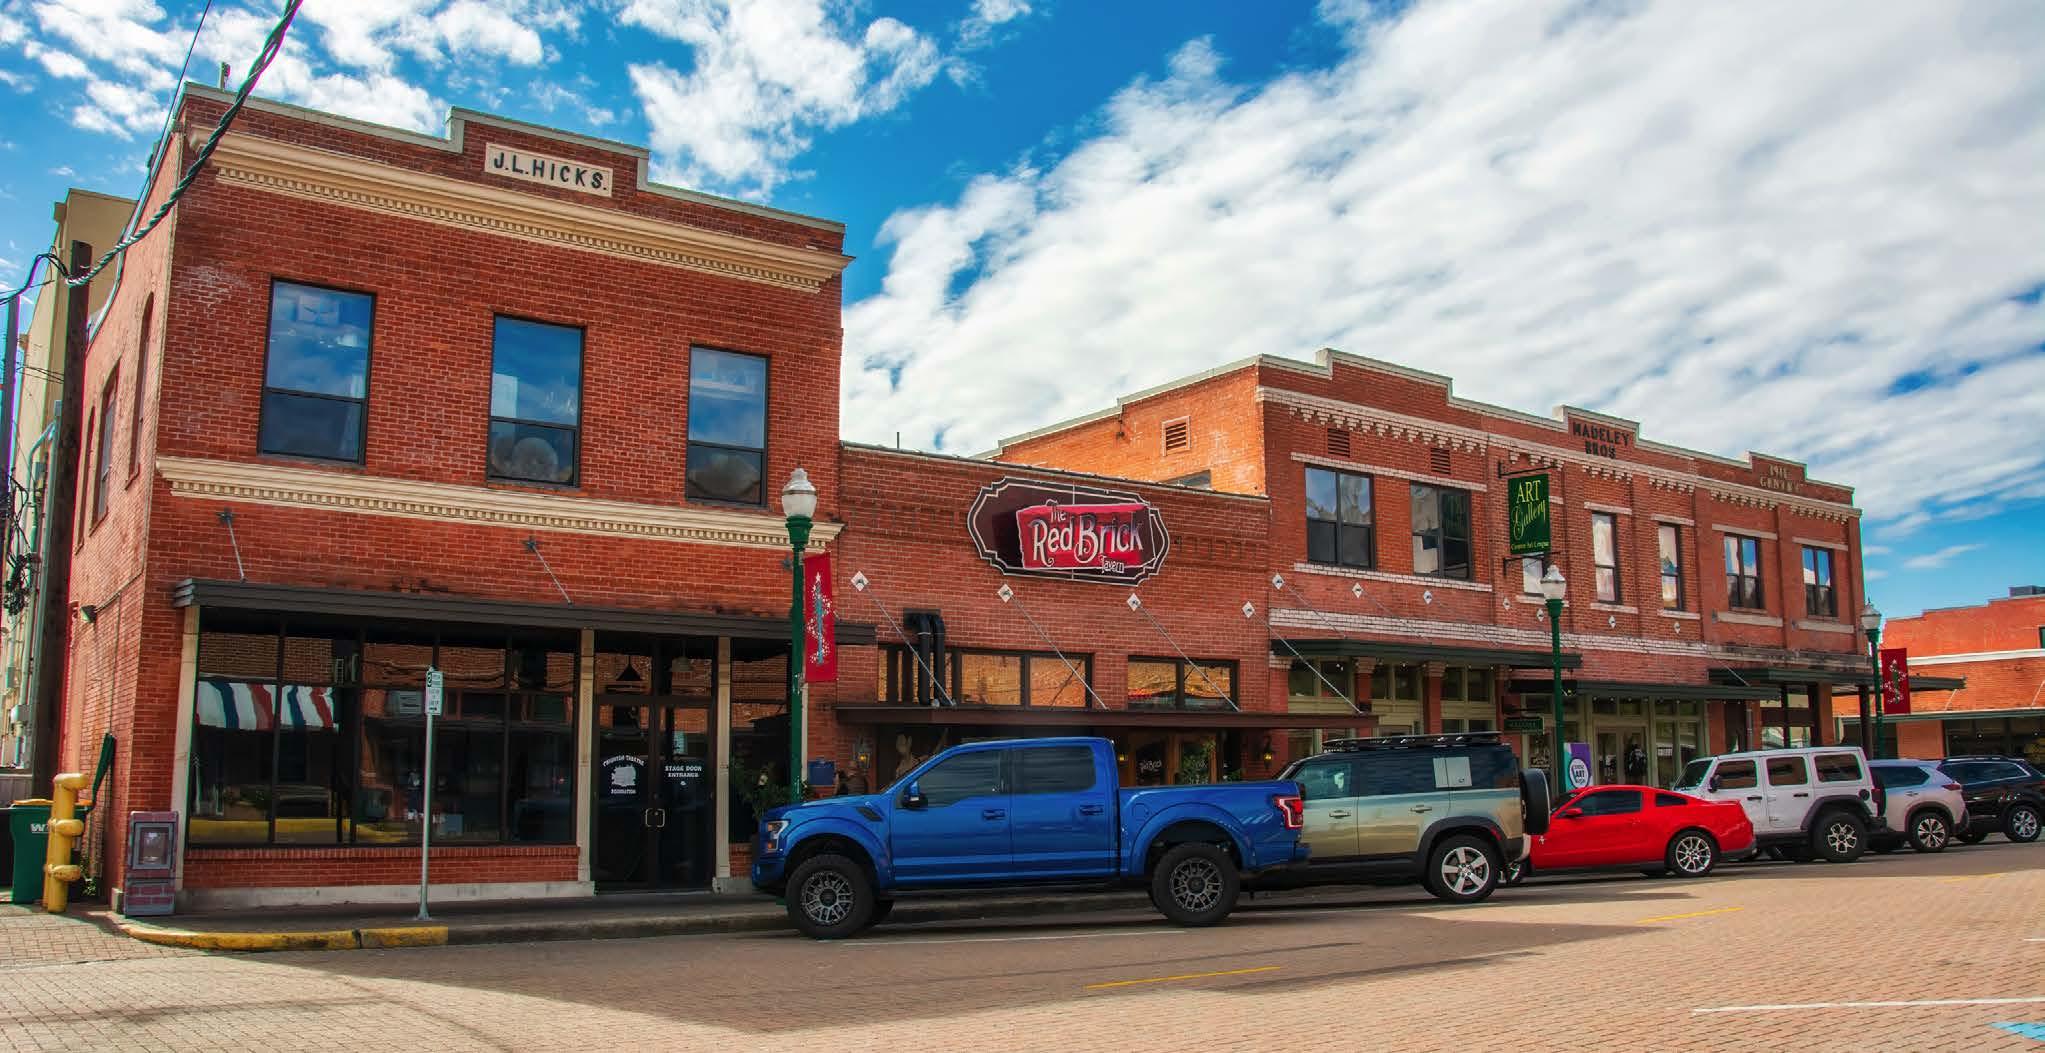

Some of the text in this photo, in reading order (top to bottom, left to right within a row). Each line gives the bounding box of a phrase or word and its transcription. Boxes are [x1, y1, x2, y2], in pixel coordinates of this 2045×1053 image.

[1572, 421, 1630, 447] MADELEY
[1516, 480, 1541, 503] ART
[1045, 498, 1067, 523] The
[1511, 499, 1546, 540] Gallery
[1027, 509, 1144, 567] Red Brick
[1099, 554, 1125, 574] Tavern
[30, 823, 48, 832] W
